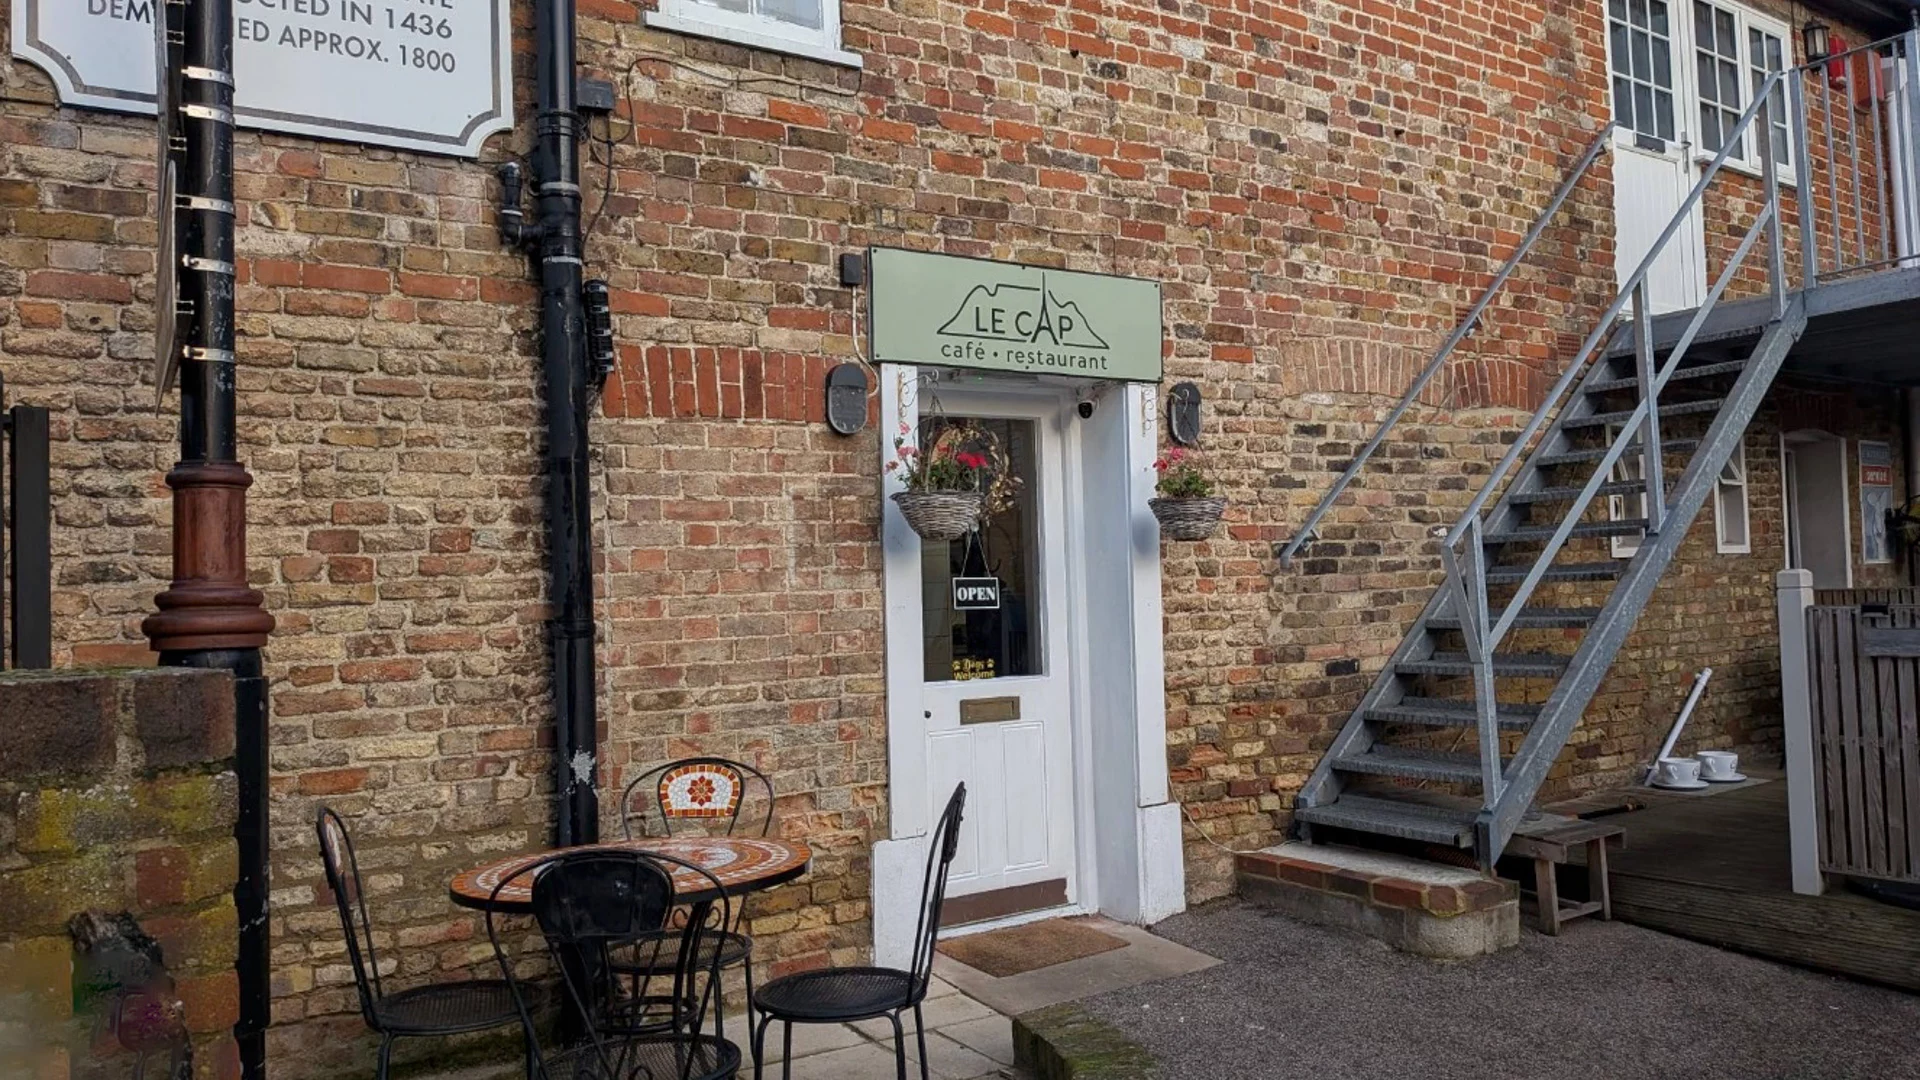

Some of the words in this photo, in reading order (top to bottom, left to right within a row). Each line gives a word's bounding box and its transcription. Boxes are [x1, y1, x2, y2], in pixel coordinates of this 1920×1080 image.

[341, 0, 373, 25] IN
[386, 8, 453, 39] 1436
[278, 25, 389, 63] APPROX.
[399, 45, 456, 73] 1800
[975, 306, 1006, 335] LE
[1014, 294, 1073, 345] CAP
[941, 341, 985, 361] café
[1007, 349, 1108, 371] restaurant
[956, 586, 996, 602] OPEN
[953, 670, 996, 680] Welcome
